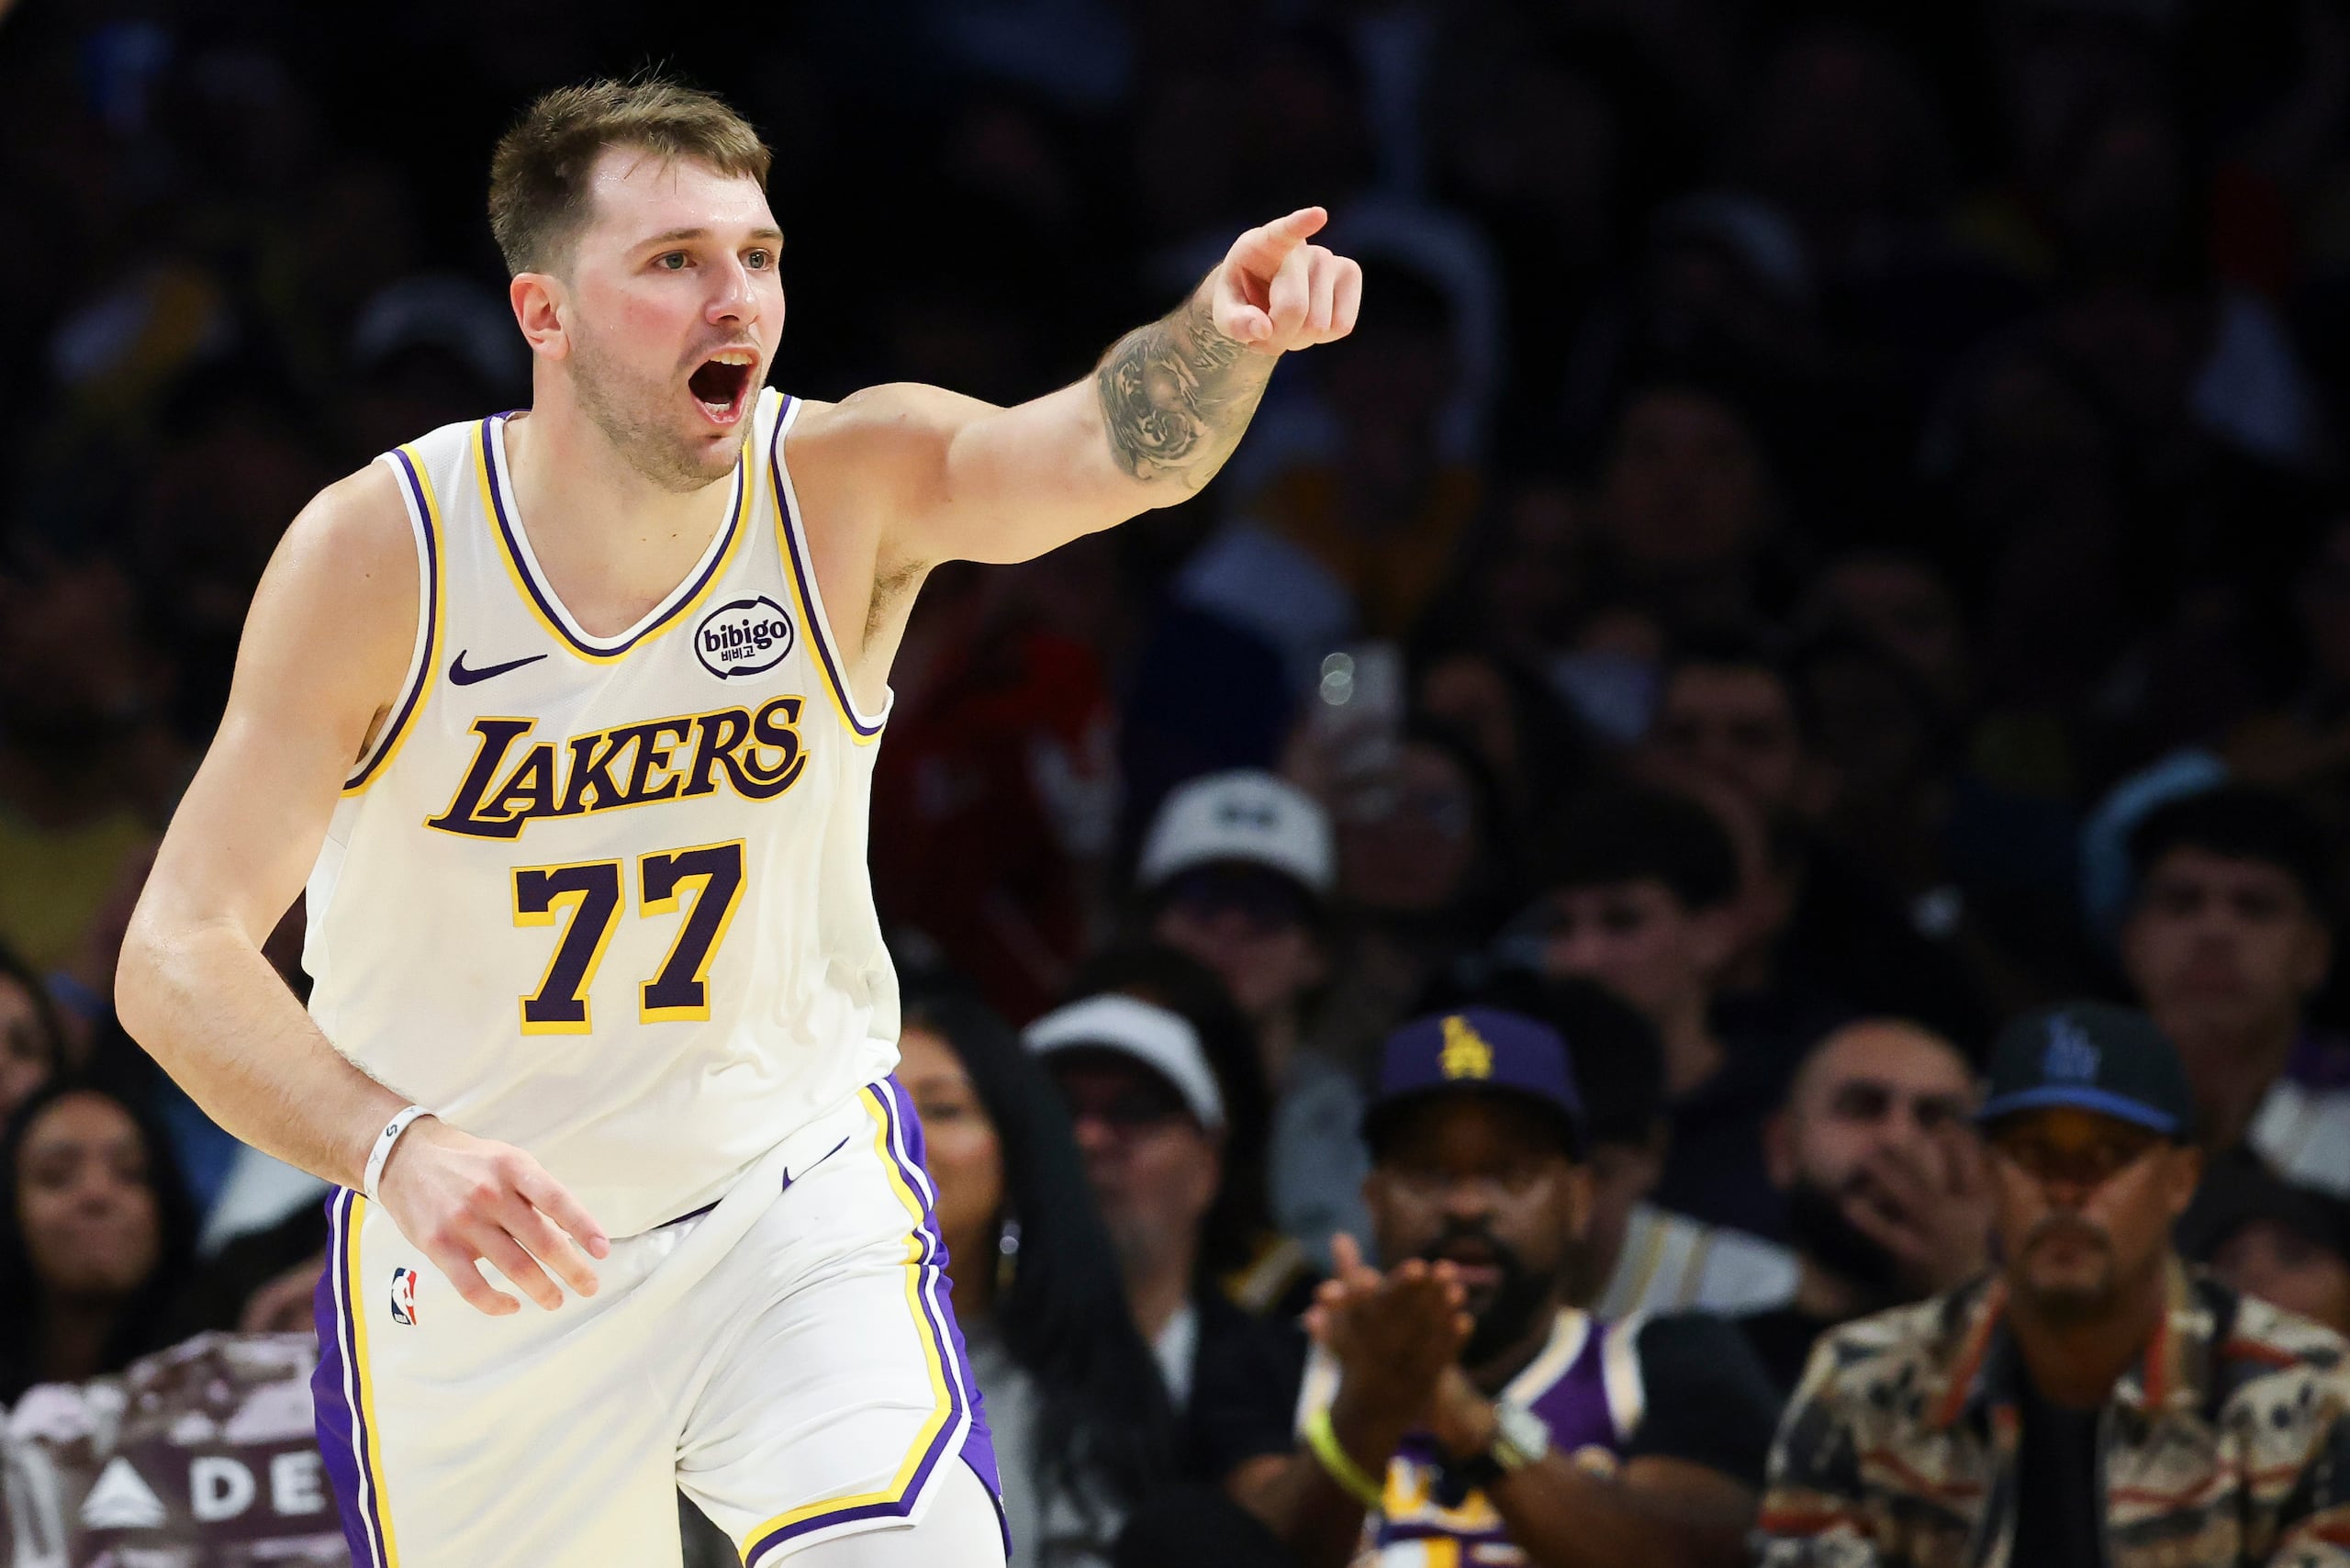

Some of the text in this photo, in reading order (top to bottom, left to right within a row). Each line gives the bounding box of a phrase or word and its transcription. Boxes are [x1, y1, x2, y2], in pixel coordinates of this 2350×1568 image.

[703, 619, 787, 650] bibigo
[721, 645, 755, 661] 비비고
[422, 695, 810, 842] LAKERS
[509, 838, 747, 1036] 77
